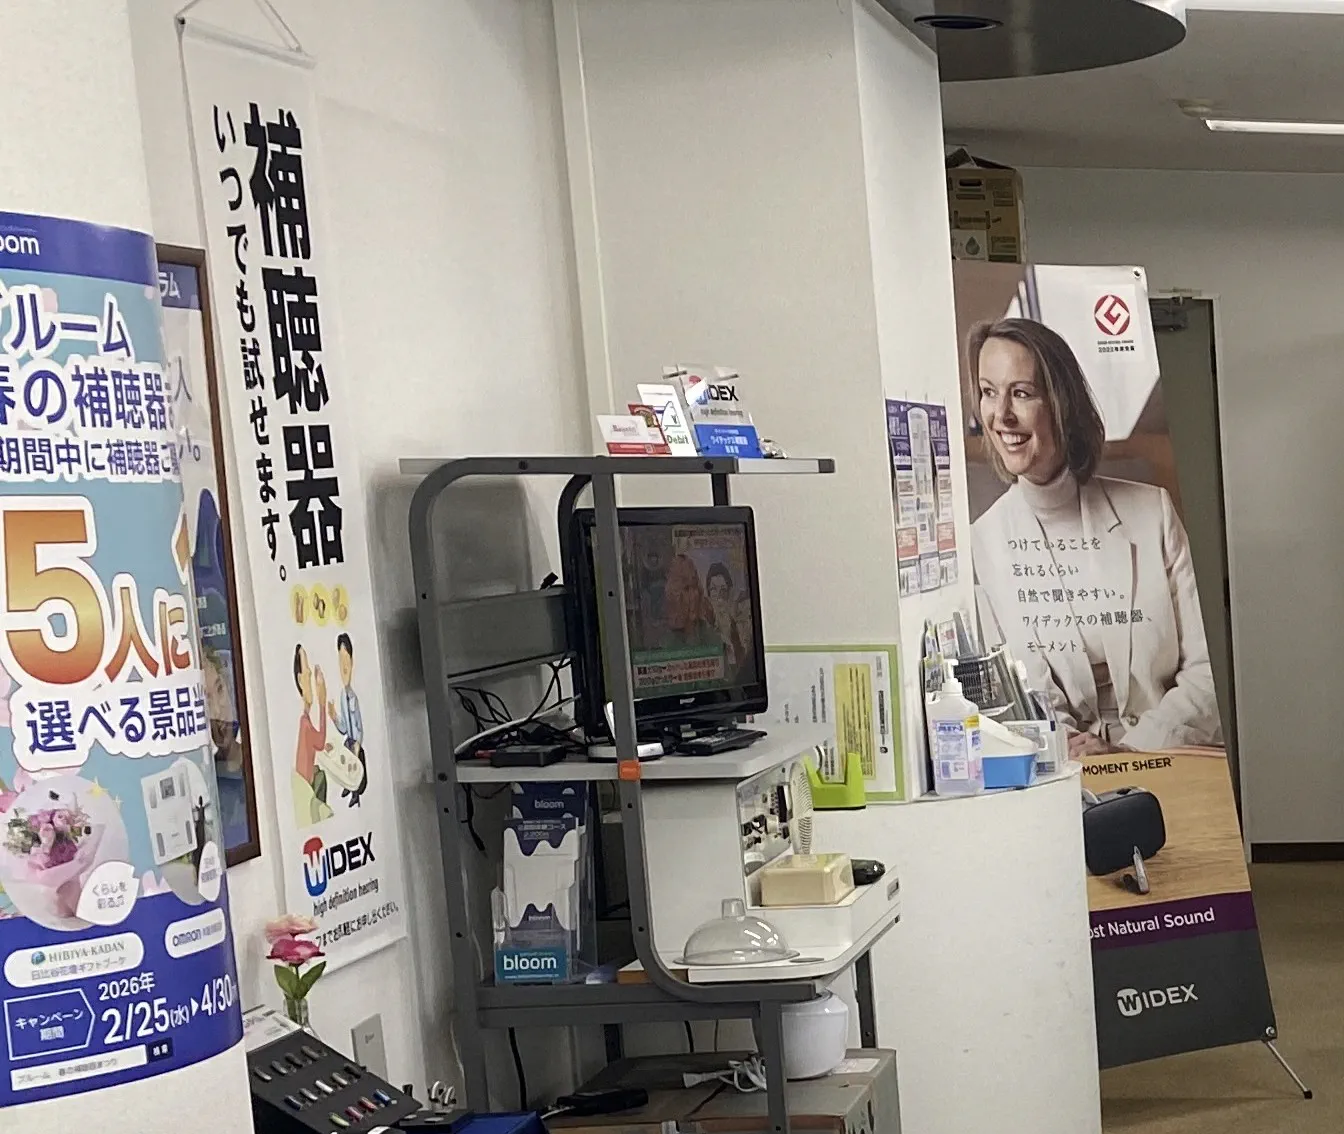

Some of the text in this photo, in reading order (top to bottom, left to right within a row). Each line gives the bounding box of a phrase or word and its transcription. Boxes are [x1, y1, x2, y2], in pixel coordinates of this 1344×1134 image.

[0, 291, 132, 358] ルーム
[244, 101, 345, 570] 補聴器
[212, 104, 288, 583] いつでも試せます。
[0, 437, 181, 475] 期間中に補聴器ご
[1008, 537, 1101, 551] つけていることを
[1012, 563, 1079, 577] 忘れるくらい
[1017, 588, 1125, 603] 自然で聞きやすい。
[1022, 609, 1153, 627] ワイデックスの補聴器、
[1082, 757, 1173, 777] MOMENT SHEER
[534, 800, 565, 809] bloom
[303, 831, 376, 897] WIDEX
[1108, 907, 1215, 938] Natural Sound
[503, 955, 557, 971] bloom
[98, 971, 156, 1001] 2026年
[1116, 984, 1199, 1017] WIDEX
[15, 1008, 85, 1030] キャンペーン
